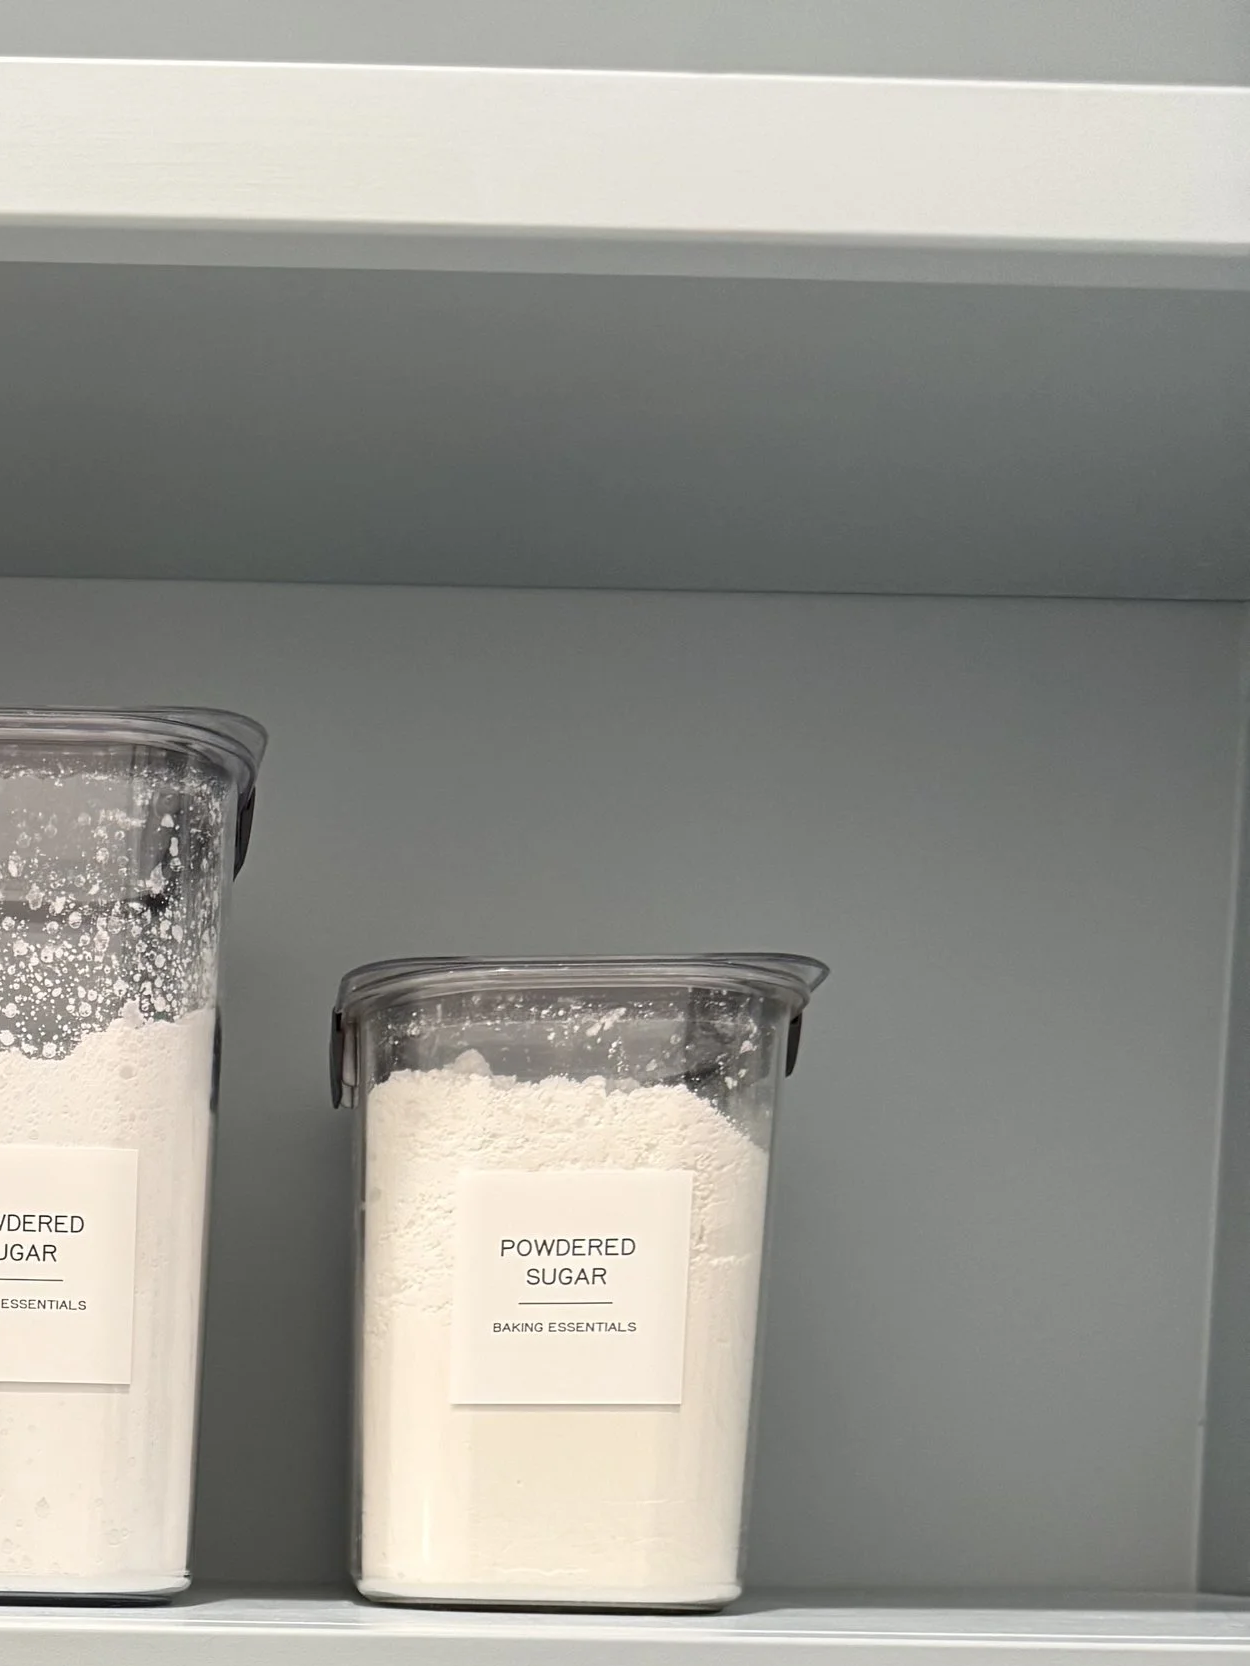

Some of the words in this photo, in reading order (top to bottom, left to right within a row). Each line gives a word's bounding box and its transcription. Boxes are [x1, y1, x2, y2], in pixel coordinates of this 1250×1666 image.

[500, 1238, 636, 1257] POWDERED
[526, 1267, 607, 1286] SUGAR
[1, 1298, 87, 1310] ESSENTIALS
[493, 1322, 543, 1333] BAKING
[548, 1322, 637, 1333] ESSENTIALS
